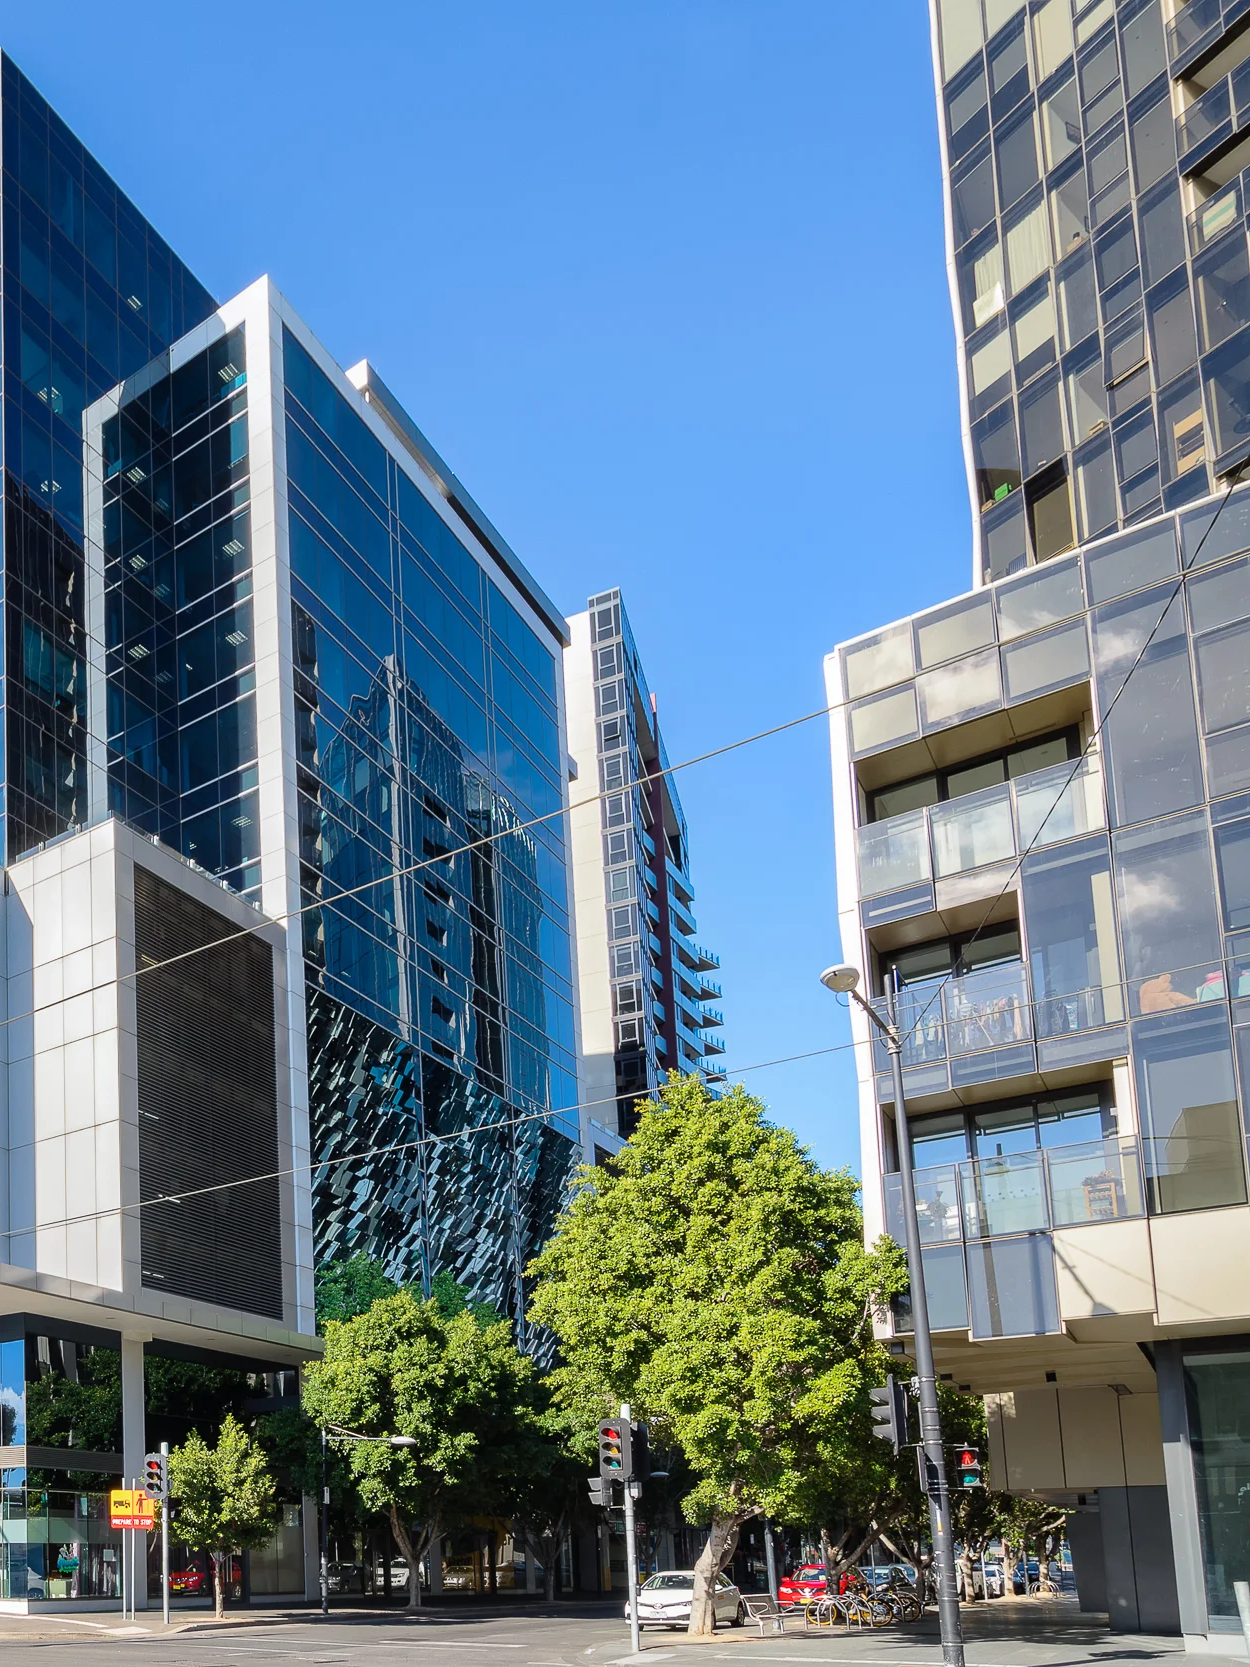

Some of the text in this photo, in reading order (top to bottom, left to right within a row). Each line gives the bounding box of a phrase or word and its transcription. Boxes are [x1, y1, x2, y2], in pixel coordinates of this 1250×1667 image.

[112, 1518, 152, 1526] PREPARE TO STOP
